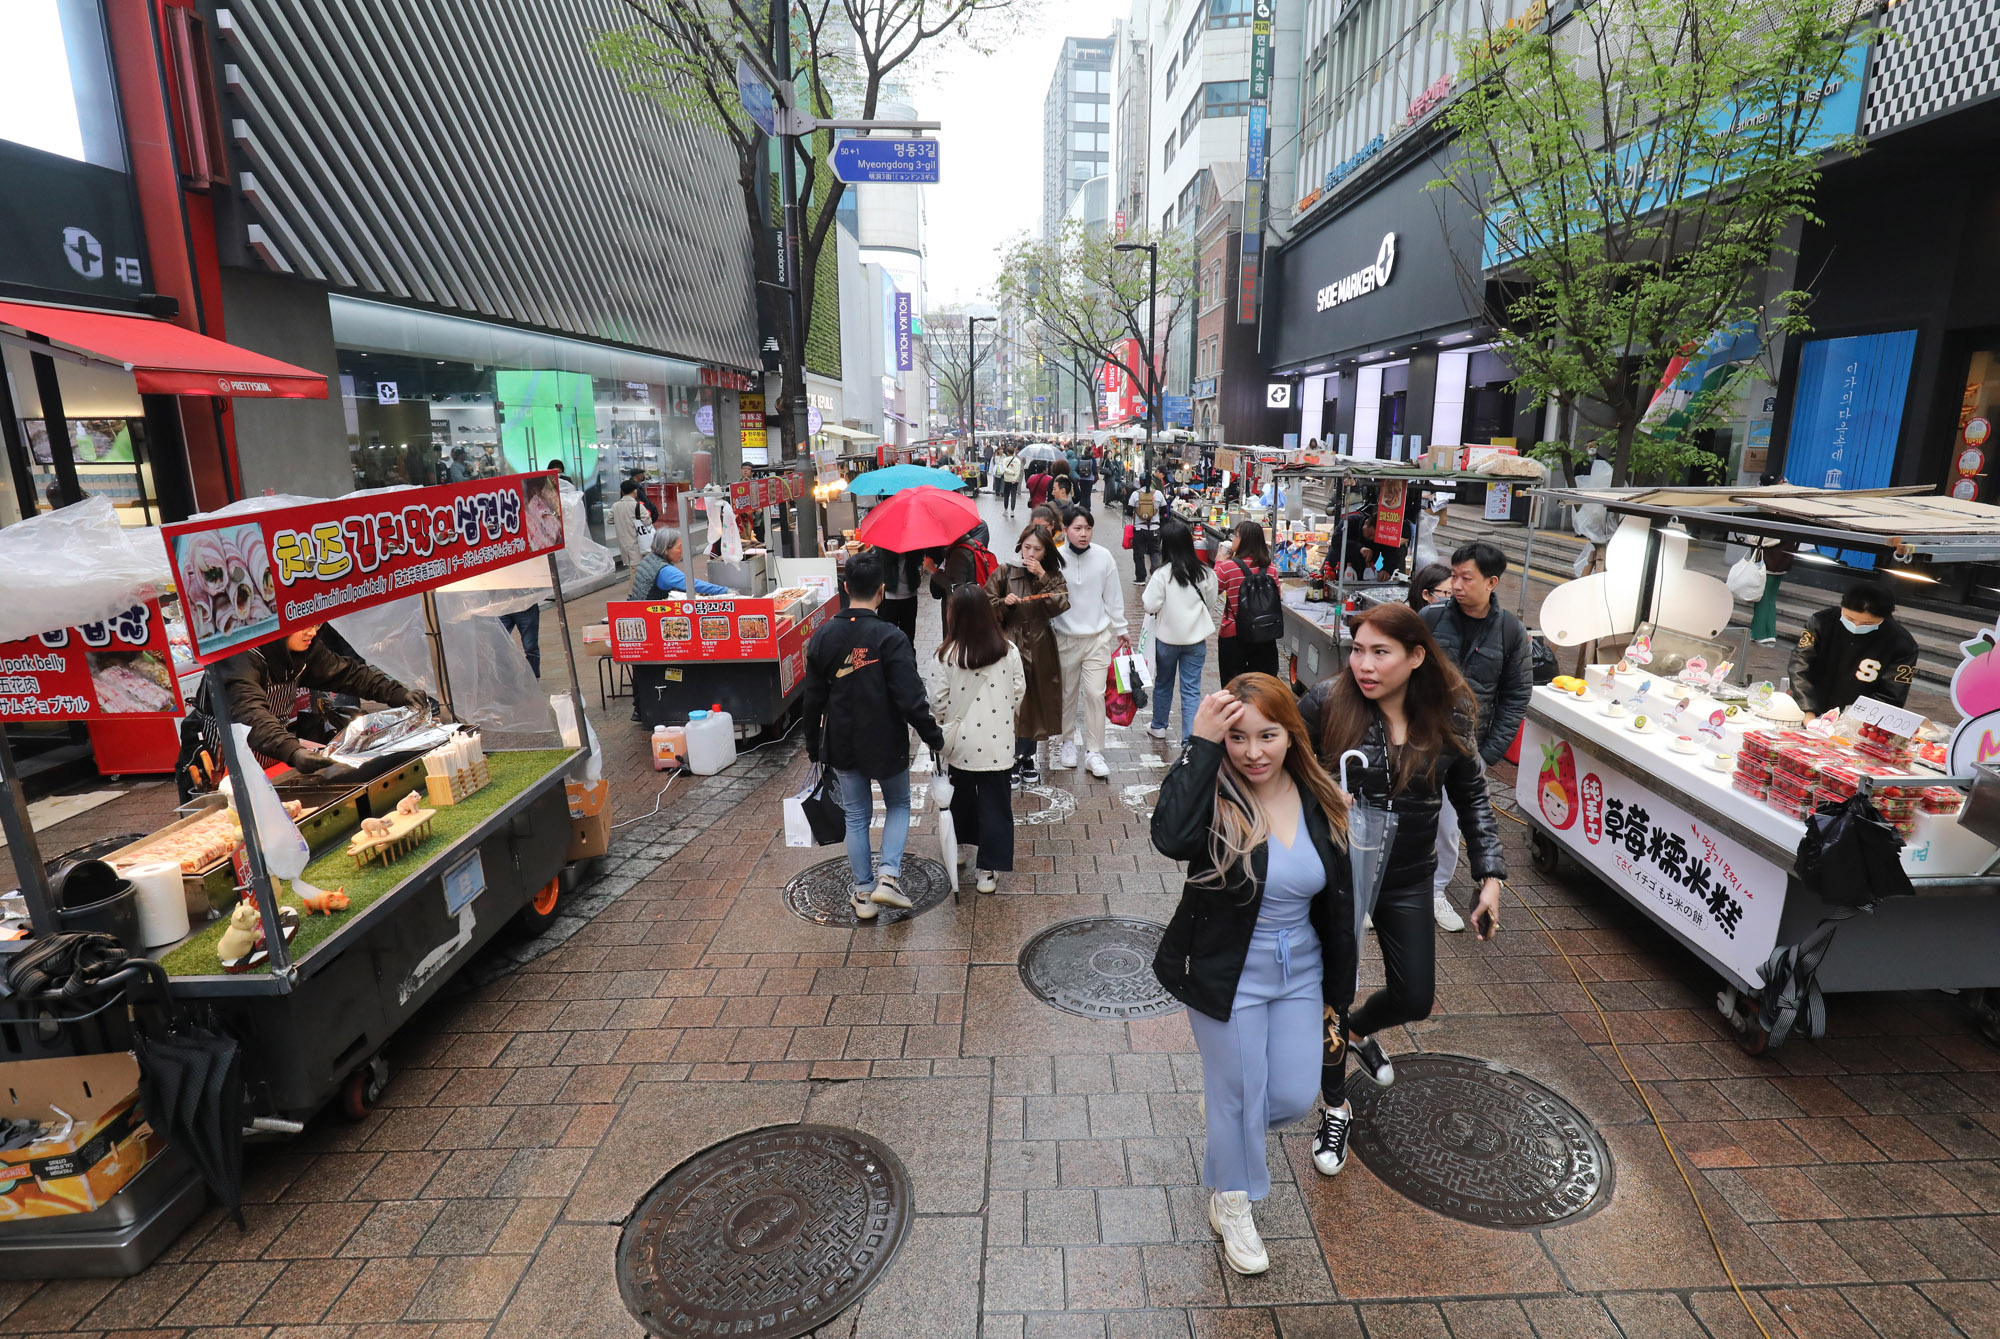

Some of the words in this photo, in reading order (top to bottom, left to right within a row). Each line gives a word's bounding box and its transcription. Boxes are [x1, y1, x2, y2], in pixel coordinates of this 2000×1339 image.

[1255, 22, 1269, 32] 치과
[857, 159, 914, 171] Myeongdong
[915, 160, 936, 171] 3-gil
[893, 143, 936, 158] 명동3길
[777, 249, 785, 282] balance
[1316, 287, 1338, 313] SHOE
[1337, 264, 1375, 303] MARKER
[899, 297, 908, 331] HOLIKA
[900, 333, 909, 367] HOLIKA
[286, 601, 314, 620] Cheese
[314, 587, 339, 609] kimchi
[339, 580, 353, 602] roll
[353, 574, 370, 599] pork
[370, 573, 387, 593] belly
[694, 602, 735, 616] 닭꼬치
[4, 655, 36, 674] pork
[34, 654, 65, 672] belly
[1855, 658, 1882, 683] S
[1604, 797, 1743, 940] 草莓糯米糕
[1614, 853, 1634, 876] てさく
[1634, 870, 1656, 891] イチゴ
[1658, 887, 1703, 927] もち米の餅
